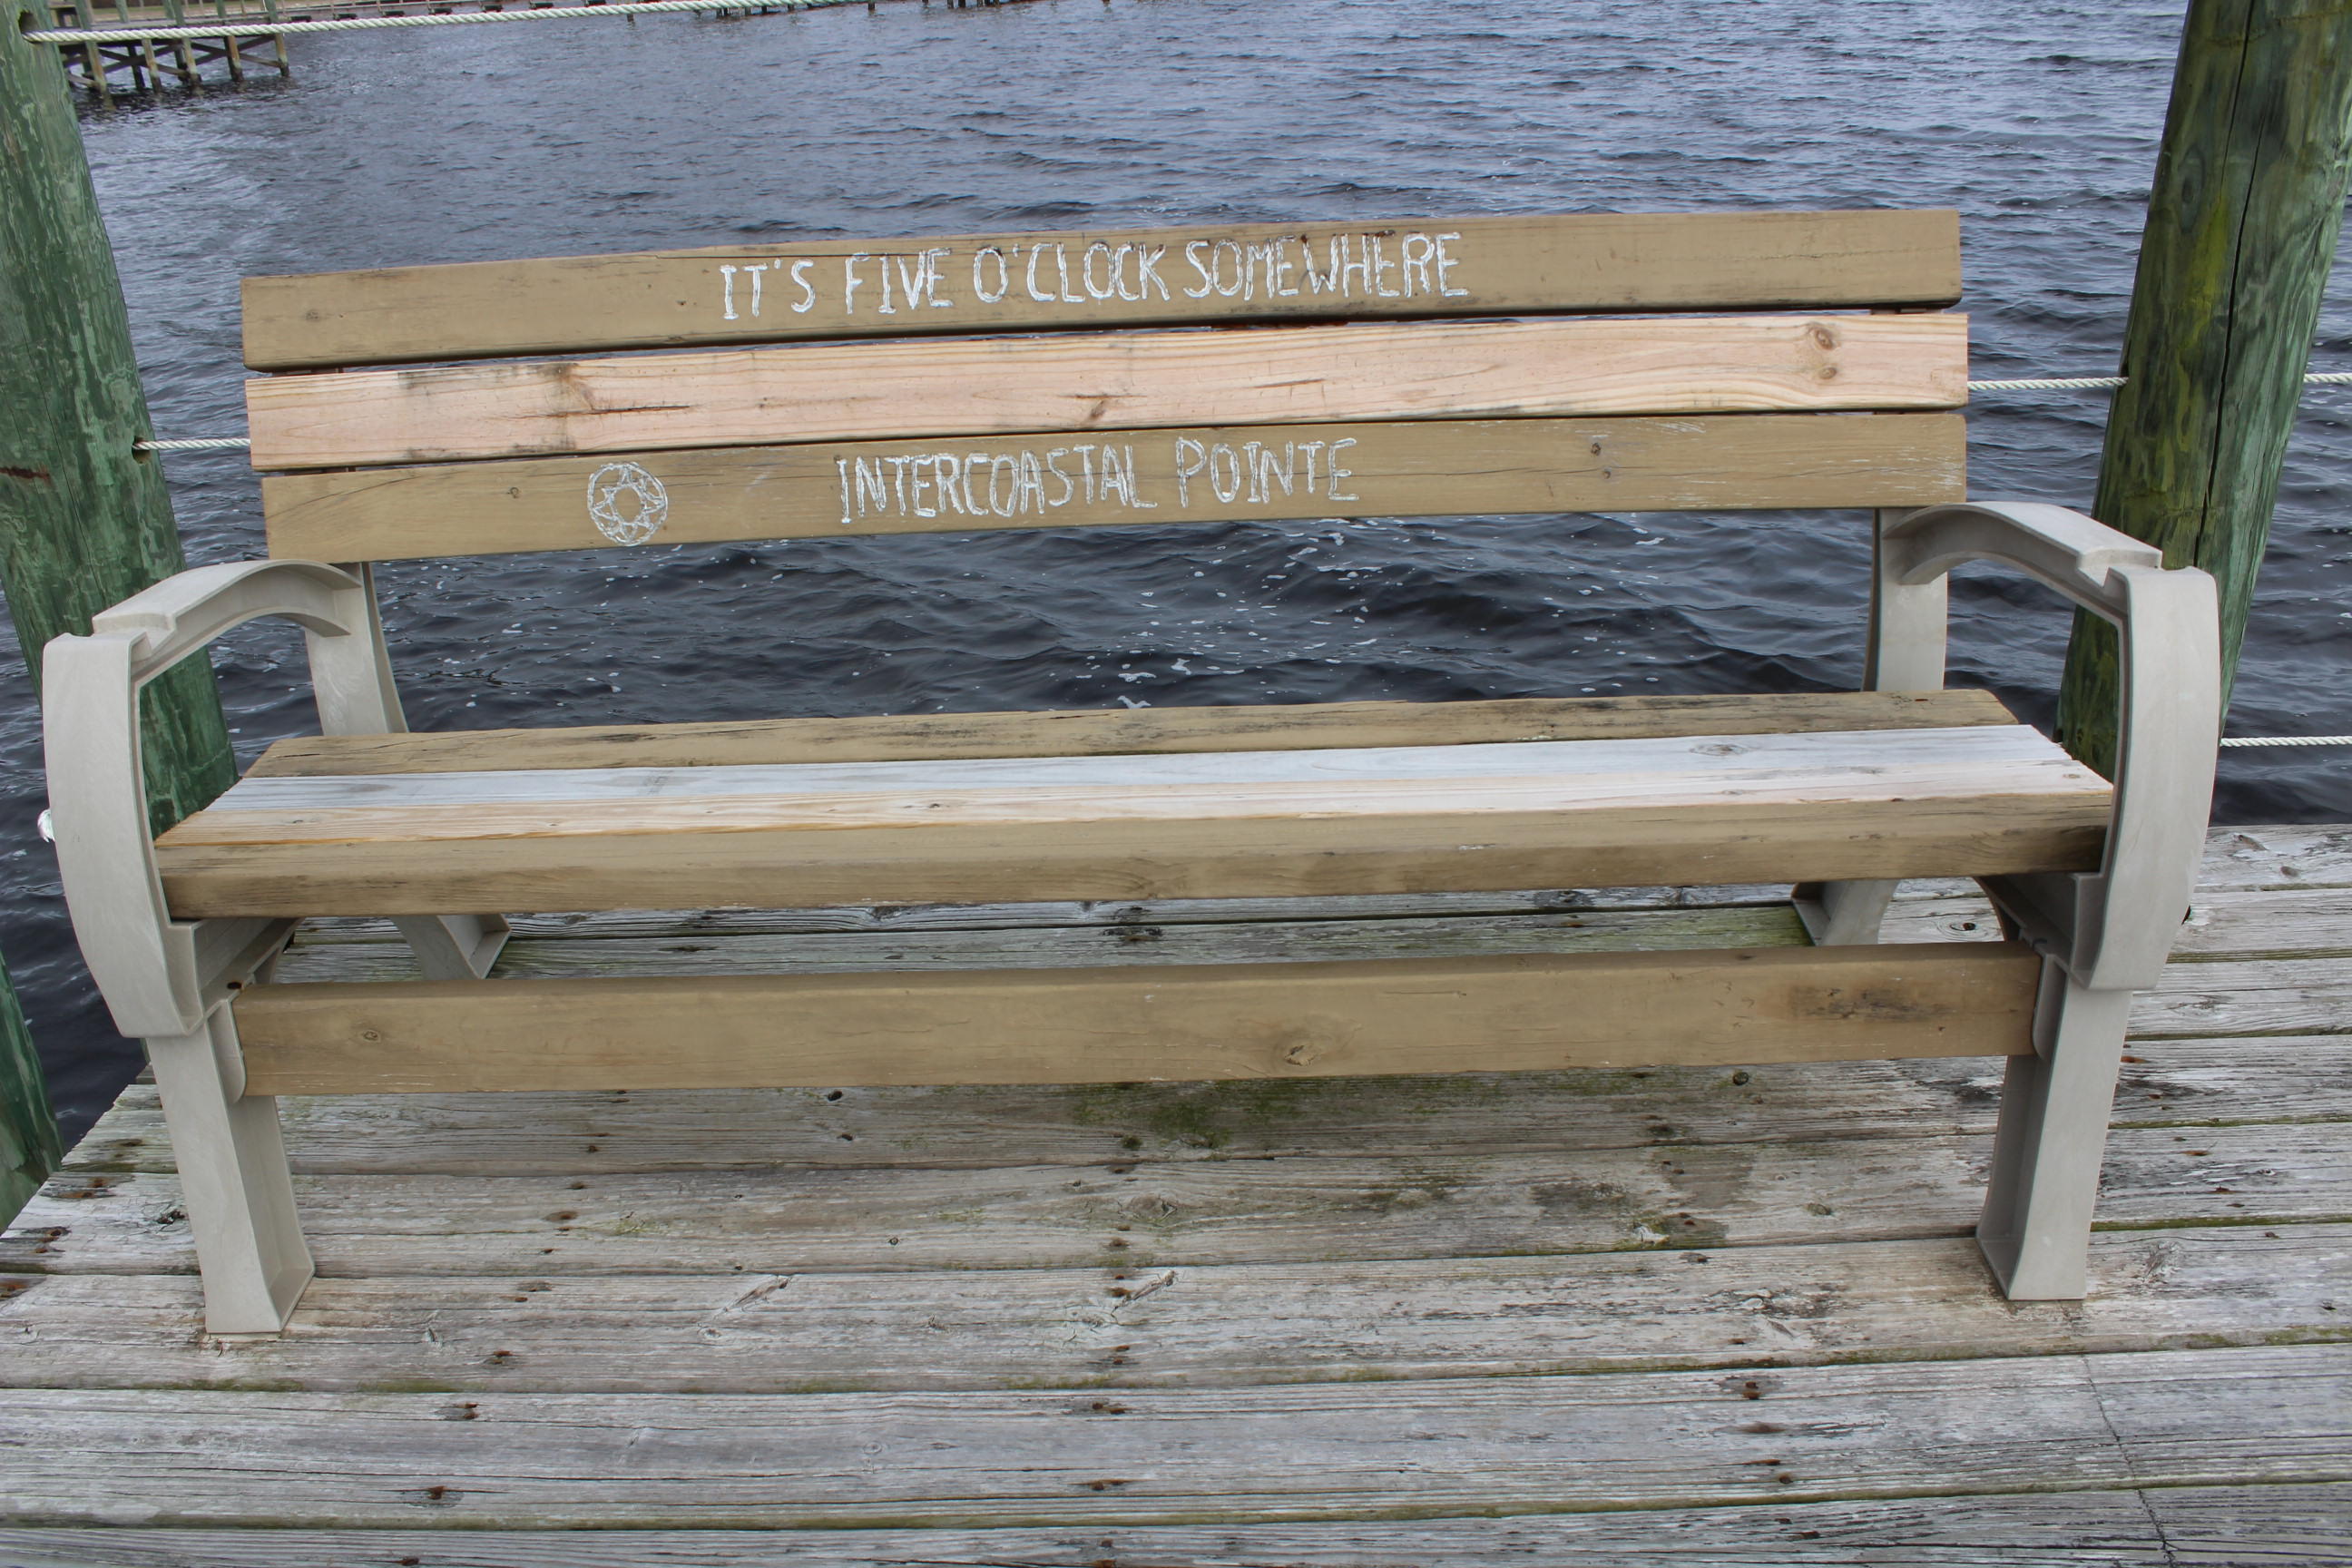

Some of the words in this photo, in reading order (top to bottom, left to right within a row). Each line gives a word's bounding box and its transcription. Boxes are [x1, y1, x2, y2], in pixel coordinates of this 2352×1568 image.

[720, 258, 816, 320] IT'S
[845, 246, 955, 315] FIVE
[973, 240, 1171, 304] O'CLOCK
[1183, 230, 1469, 301] SOMEWHERE
[834, 444, 1158, 524] INTERCOASTAL
[1177, 436, 1359, 508] POINTE
